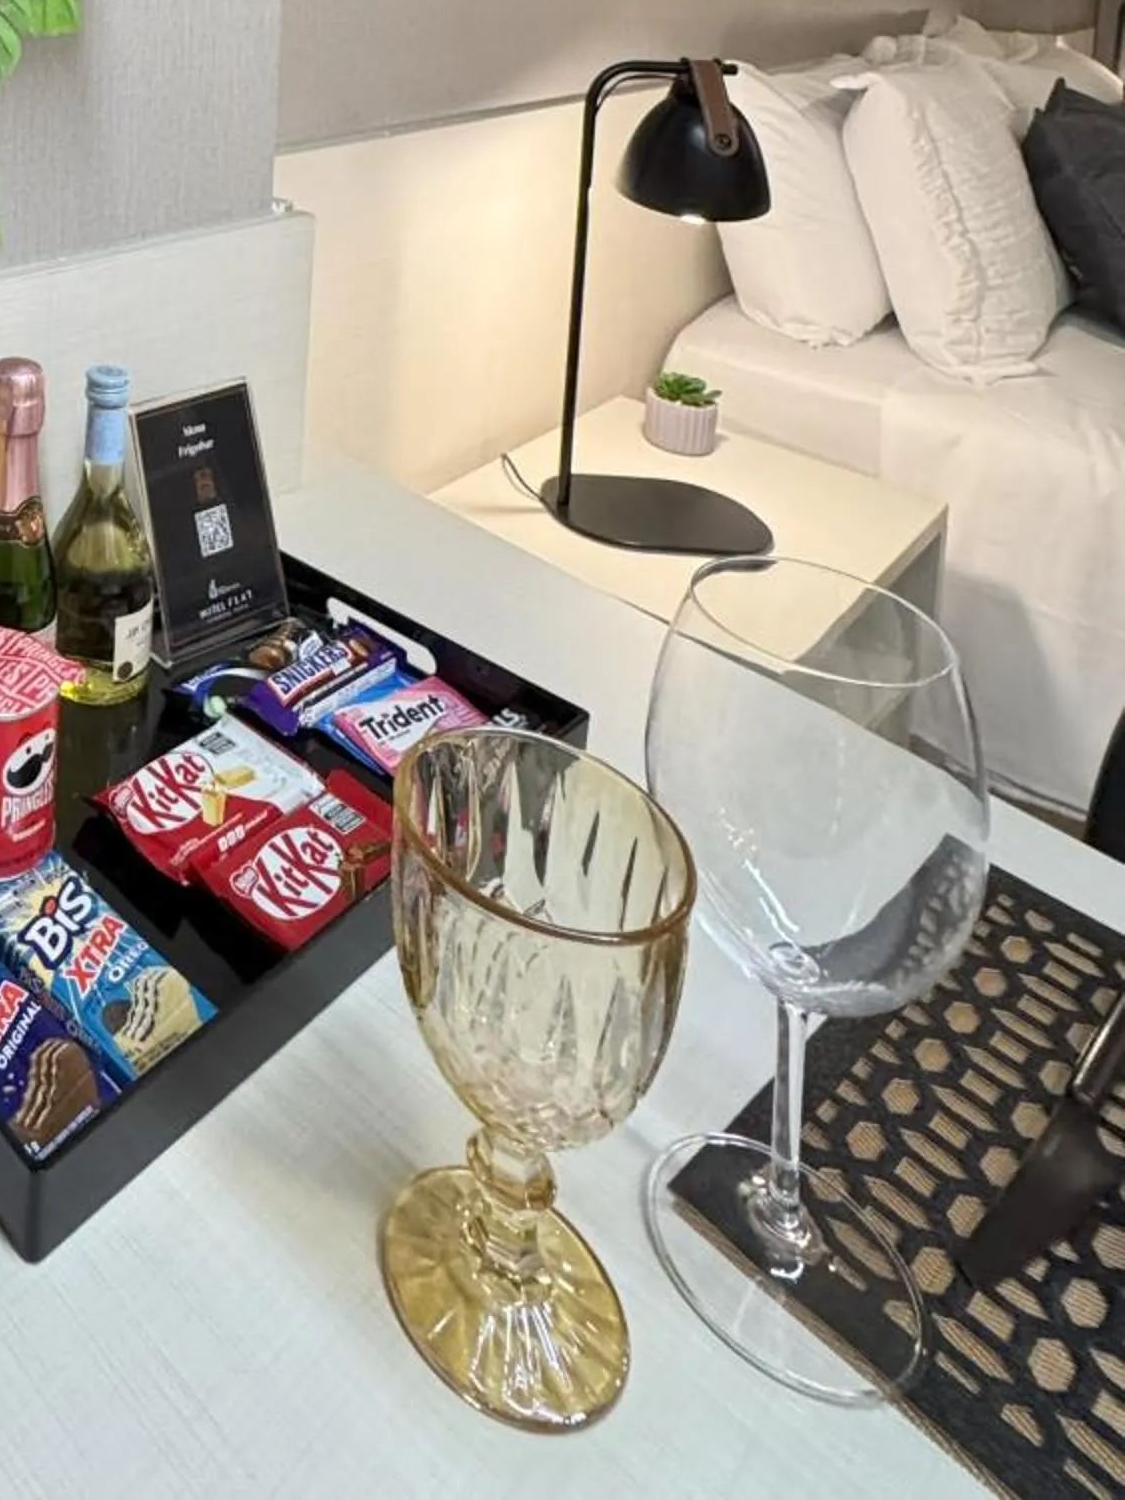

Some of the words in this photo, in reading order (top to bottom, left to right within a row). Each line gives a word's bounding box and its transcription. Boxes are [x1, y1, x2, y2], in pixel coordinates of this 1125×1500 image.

[272, 644, 349, 694] SNICKERS
[360, 694, 445, 742] Trident
[63, 915, 127, 1000] XTRA
